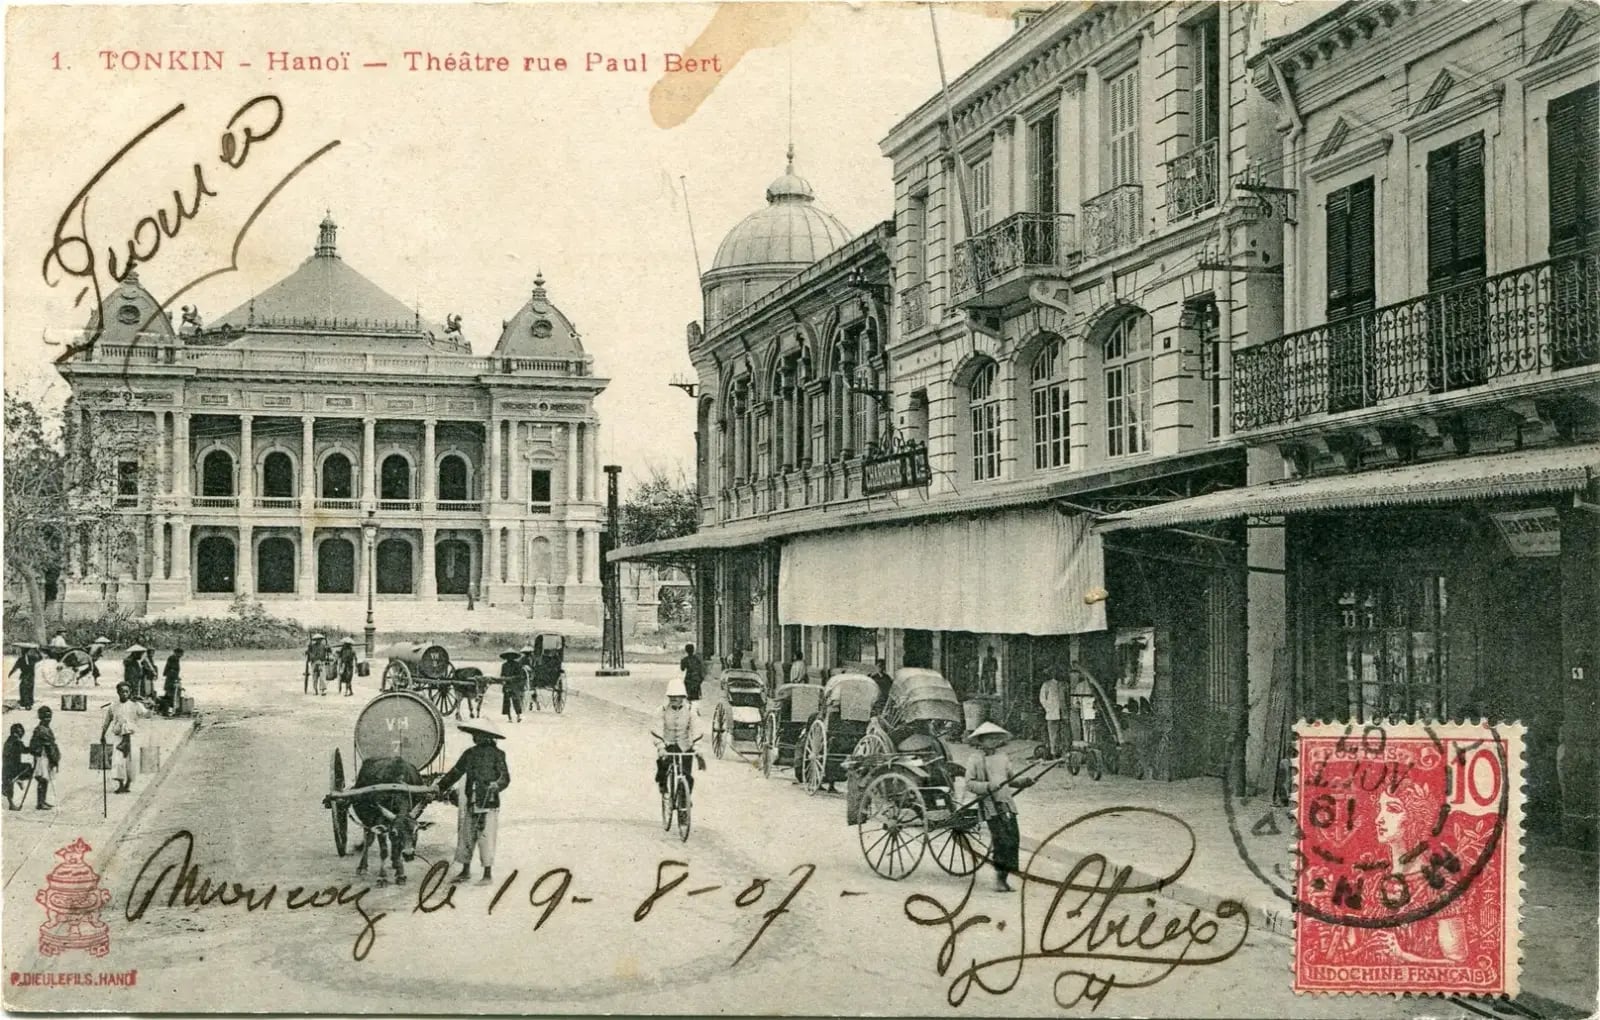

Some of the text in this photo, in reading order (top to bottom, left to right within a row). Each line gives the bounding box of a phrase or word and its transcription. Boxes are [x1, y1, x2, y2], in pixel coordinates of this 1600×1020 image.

[385, 716, 409, 731] VH
[1450, 748, 1502, 807] 10
[1307, 966, 1404, 983] INDOCHINE
